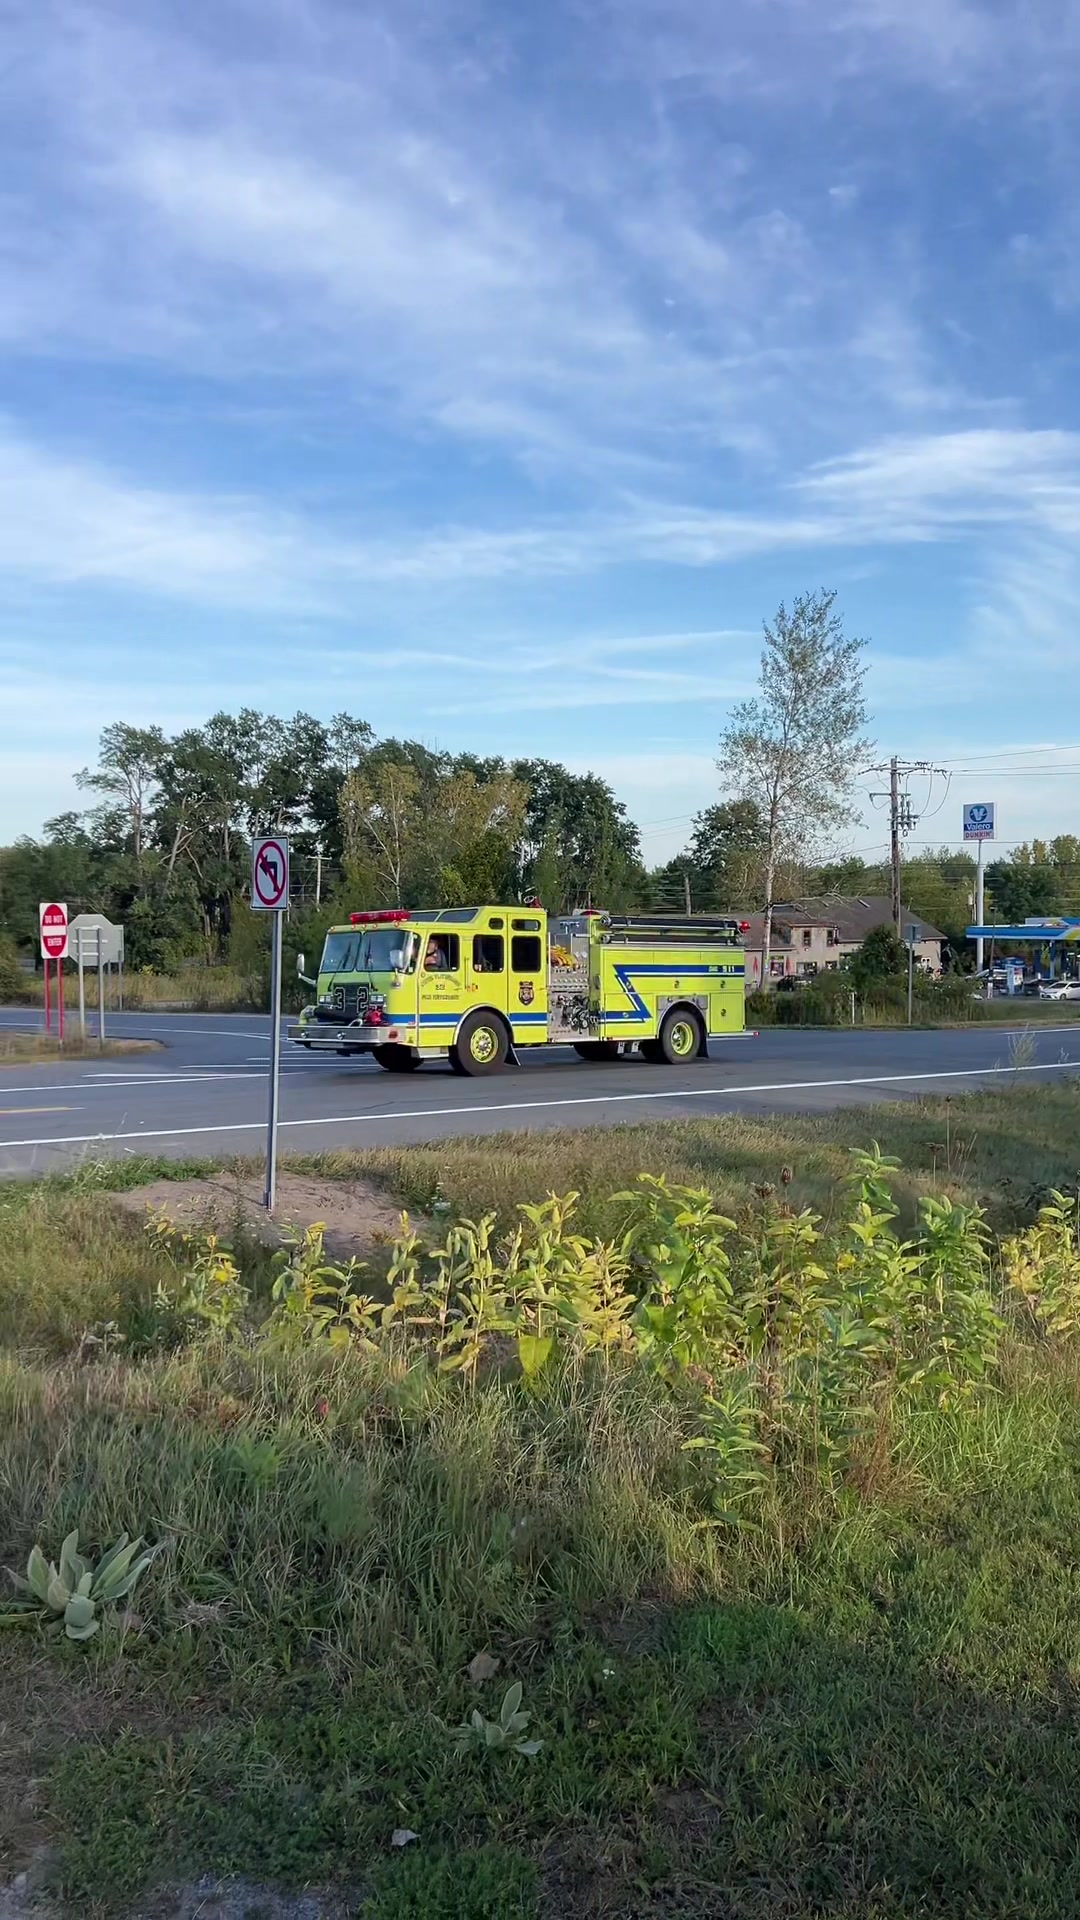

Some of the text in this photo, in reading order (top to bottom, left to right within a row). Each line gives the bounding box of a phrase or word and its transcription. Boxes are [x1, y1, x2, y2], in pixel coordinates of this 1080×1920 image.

[966, 823, 991, 831] Valero
[44, 915, 63, 924] DO NOT
